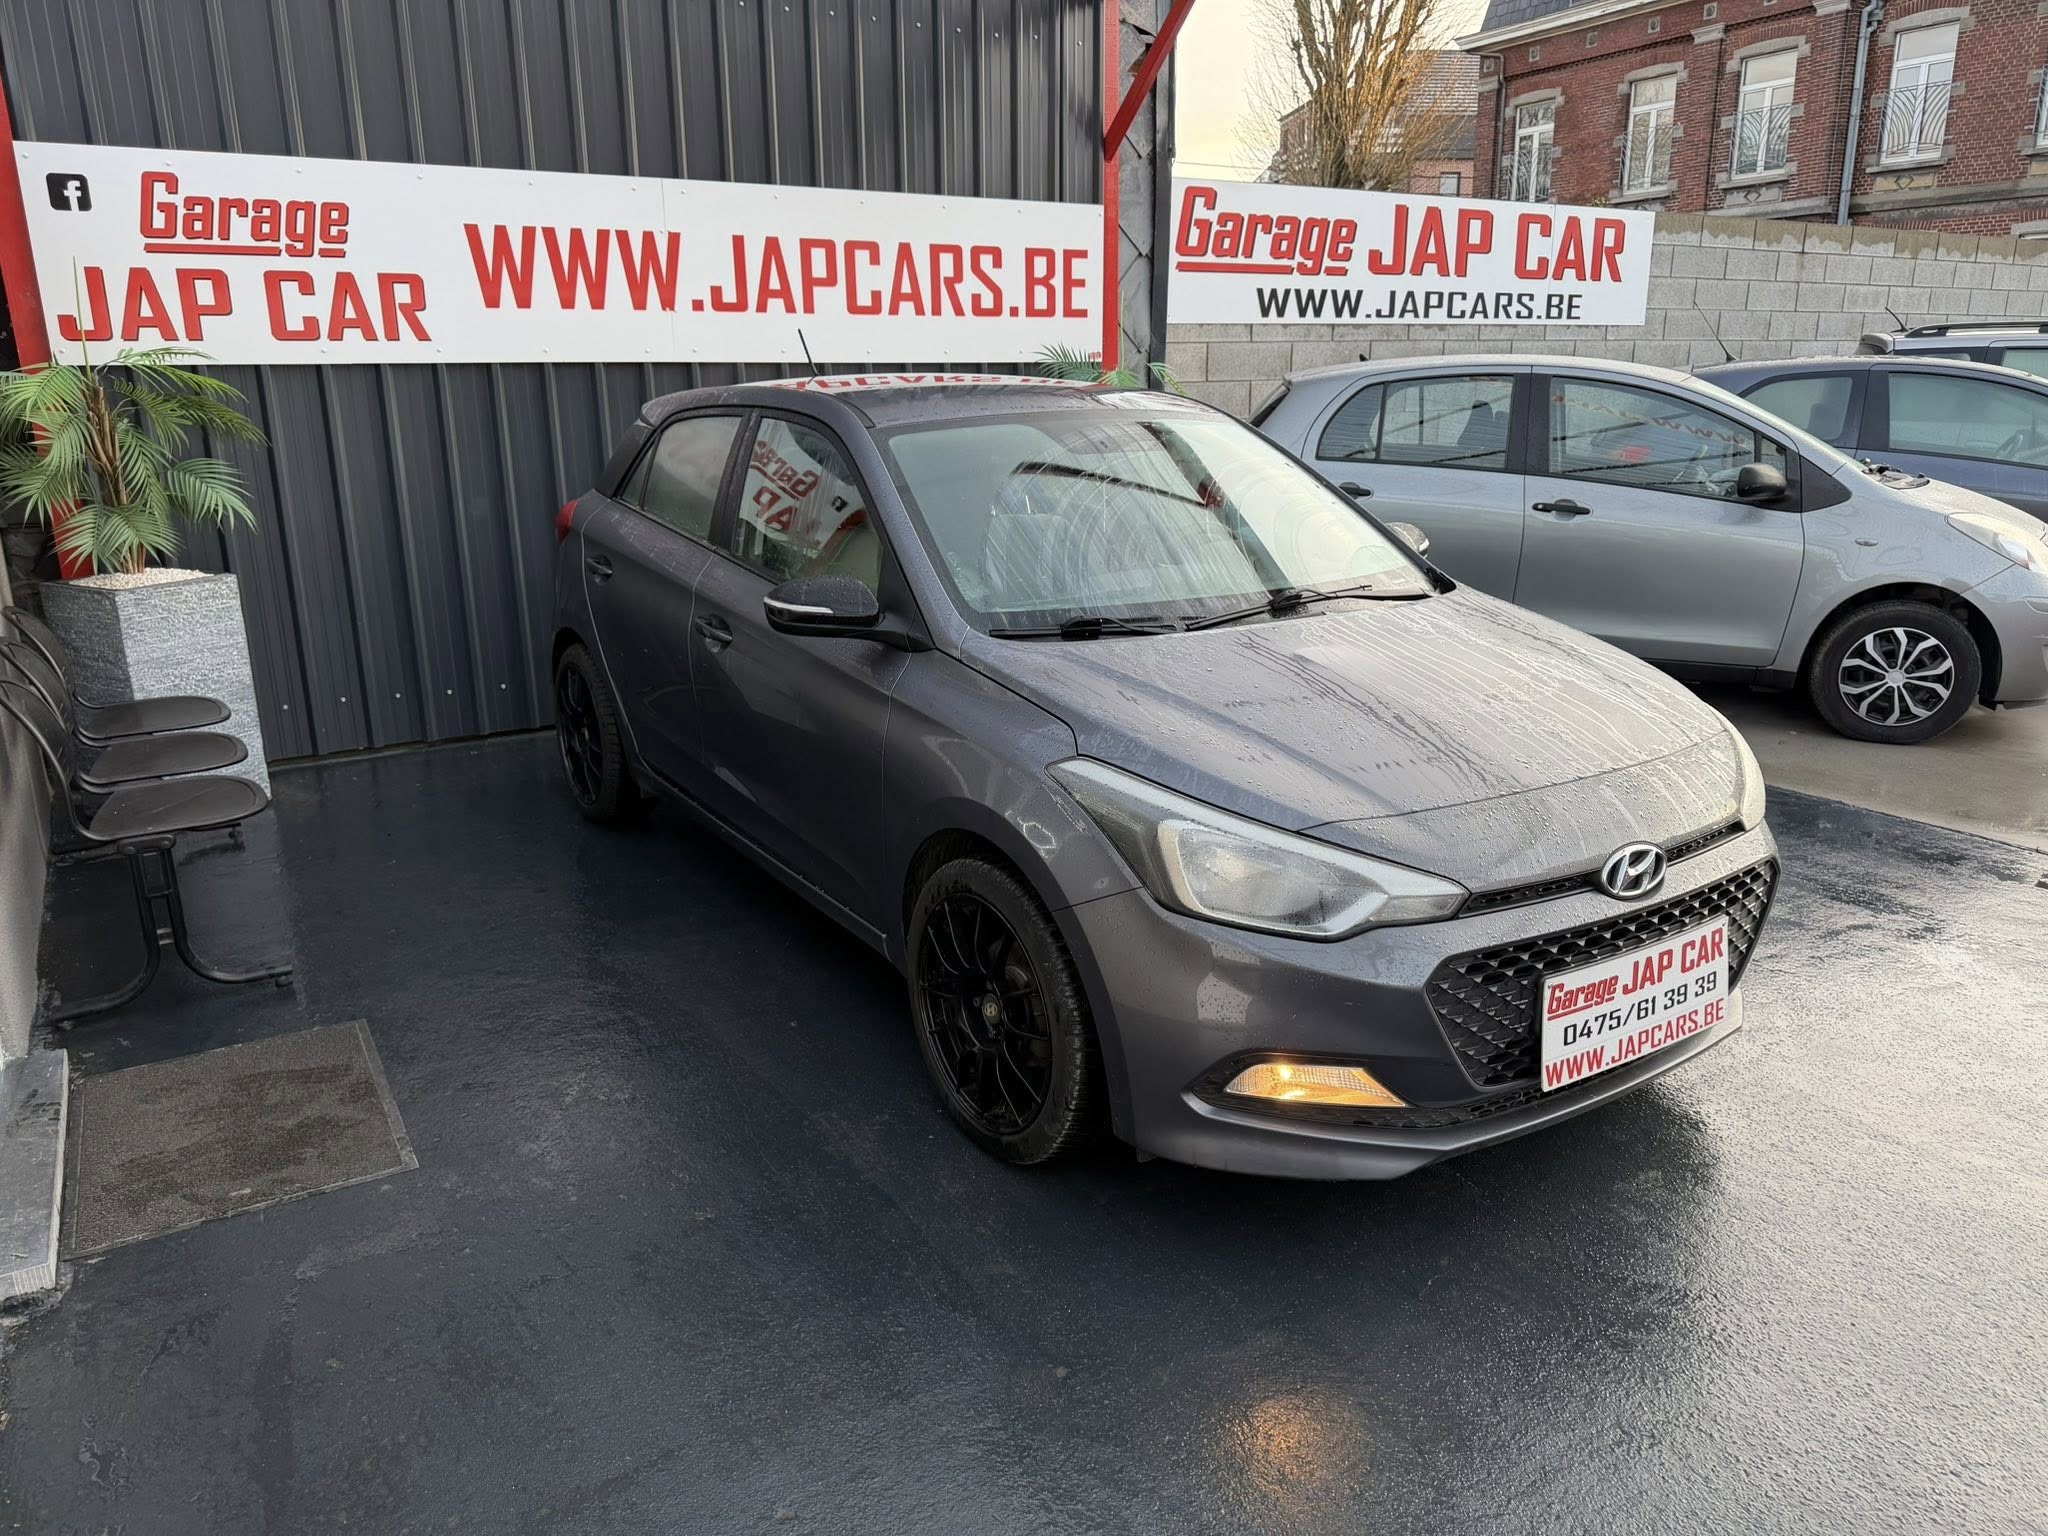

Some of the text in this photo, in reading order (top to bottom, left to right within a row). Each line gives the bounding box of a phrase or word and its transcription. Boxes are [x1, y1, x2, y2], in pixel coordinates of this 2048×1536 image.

[140, 170, 350, 257] Garage
[1174, 185, 1626, 283] Garage JAP CAR
[57, 265, 432, 341] JAP CAR
[463, 222, 1089, 319] WWW.JAPCARS.BE
[1256, 287, 1583, 321] WWW.JAPCARS.BE
[1547, 927, 1724, 1020] Garage JAP CAR
[1563, 971, 1718, 1047] 0475/61 39 39
[1545, 998, 1725, 1088] WWW.JAPCARS.BE
